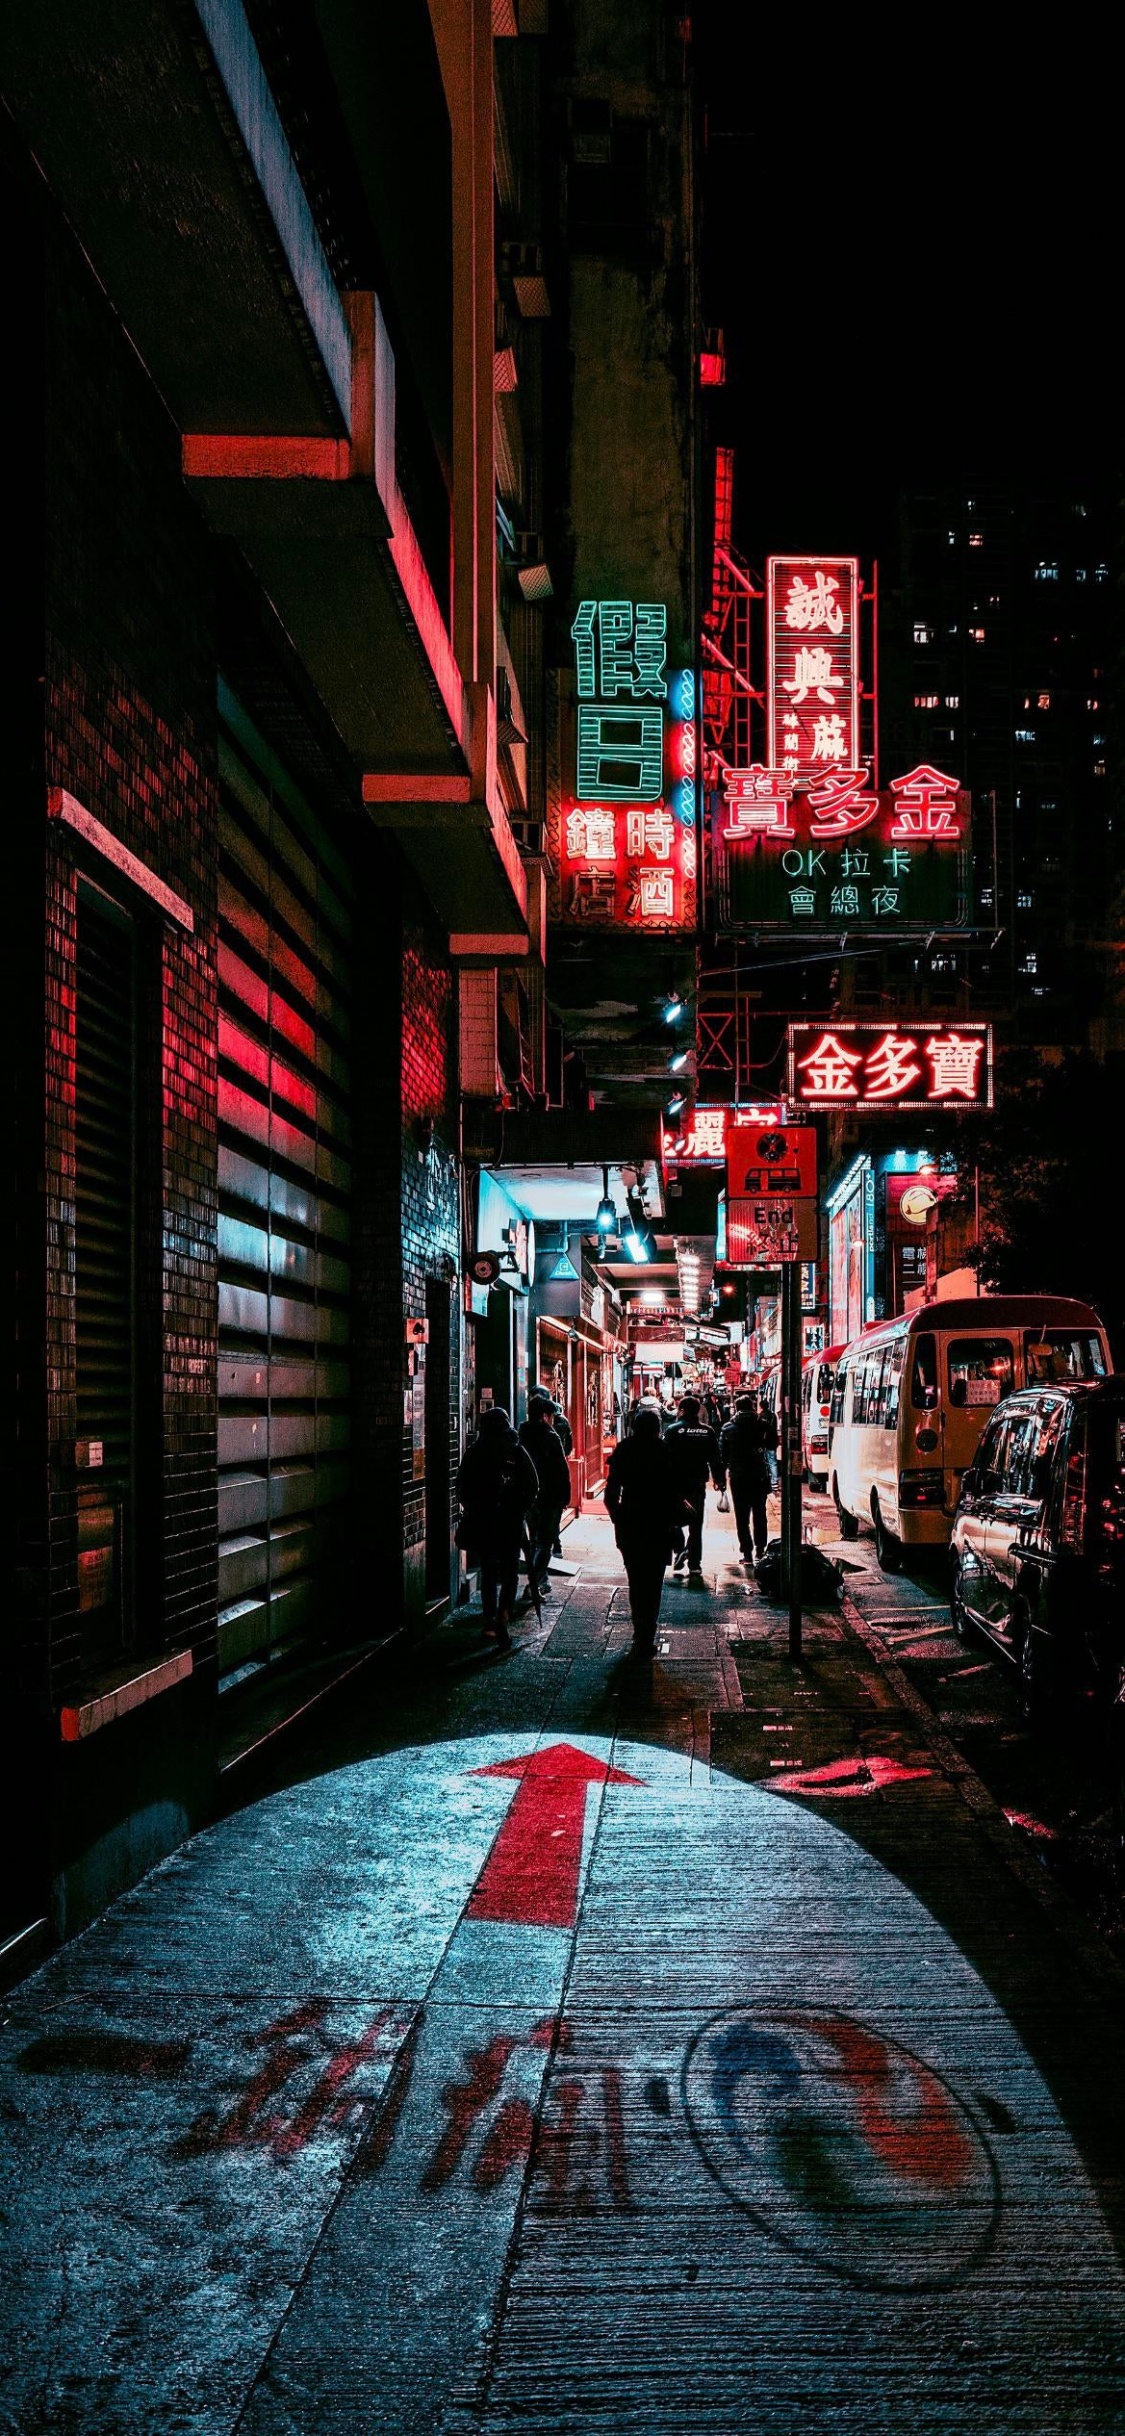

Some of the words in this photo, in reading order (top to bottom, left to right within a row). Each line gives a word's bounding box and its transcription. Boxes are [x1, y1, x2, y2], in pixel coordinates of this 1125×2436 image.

[571, 600, 668, 801] 假日
[797, 1033, 985, 1099] 金多寶
[754, 1207, 793, 1224] End
[747, 1232, 800, 1254] 終止
